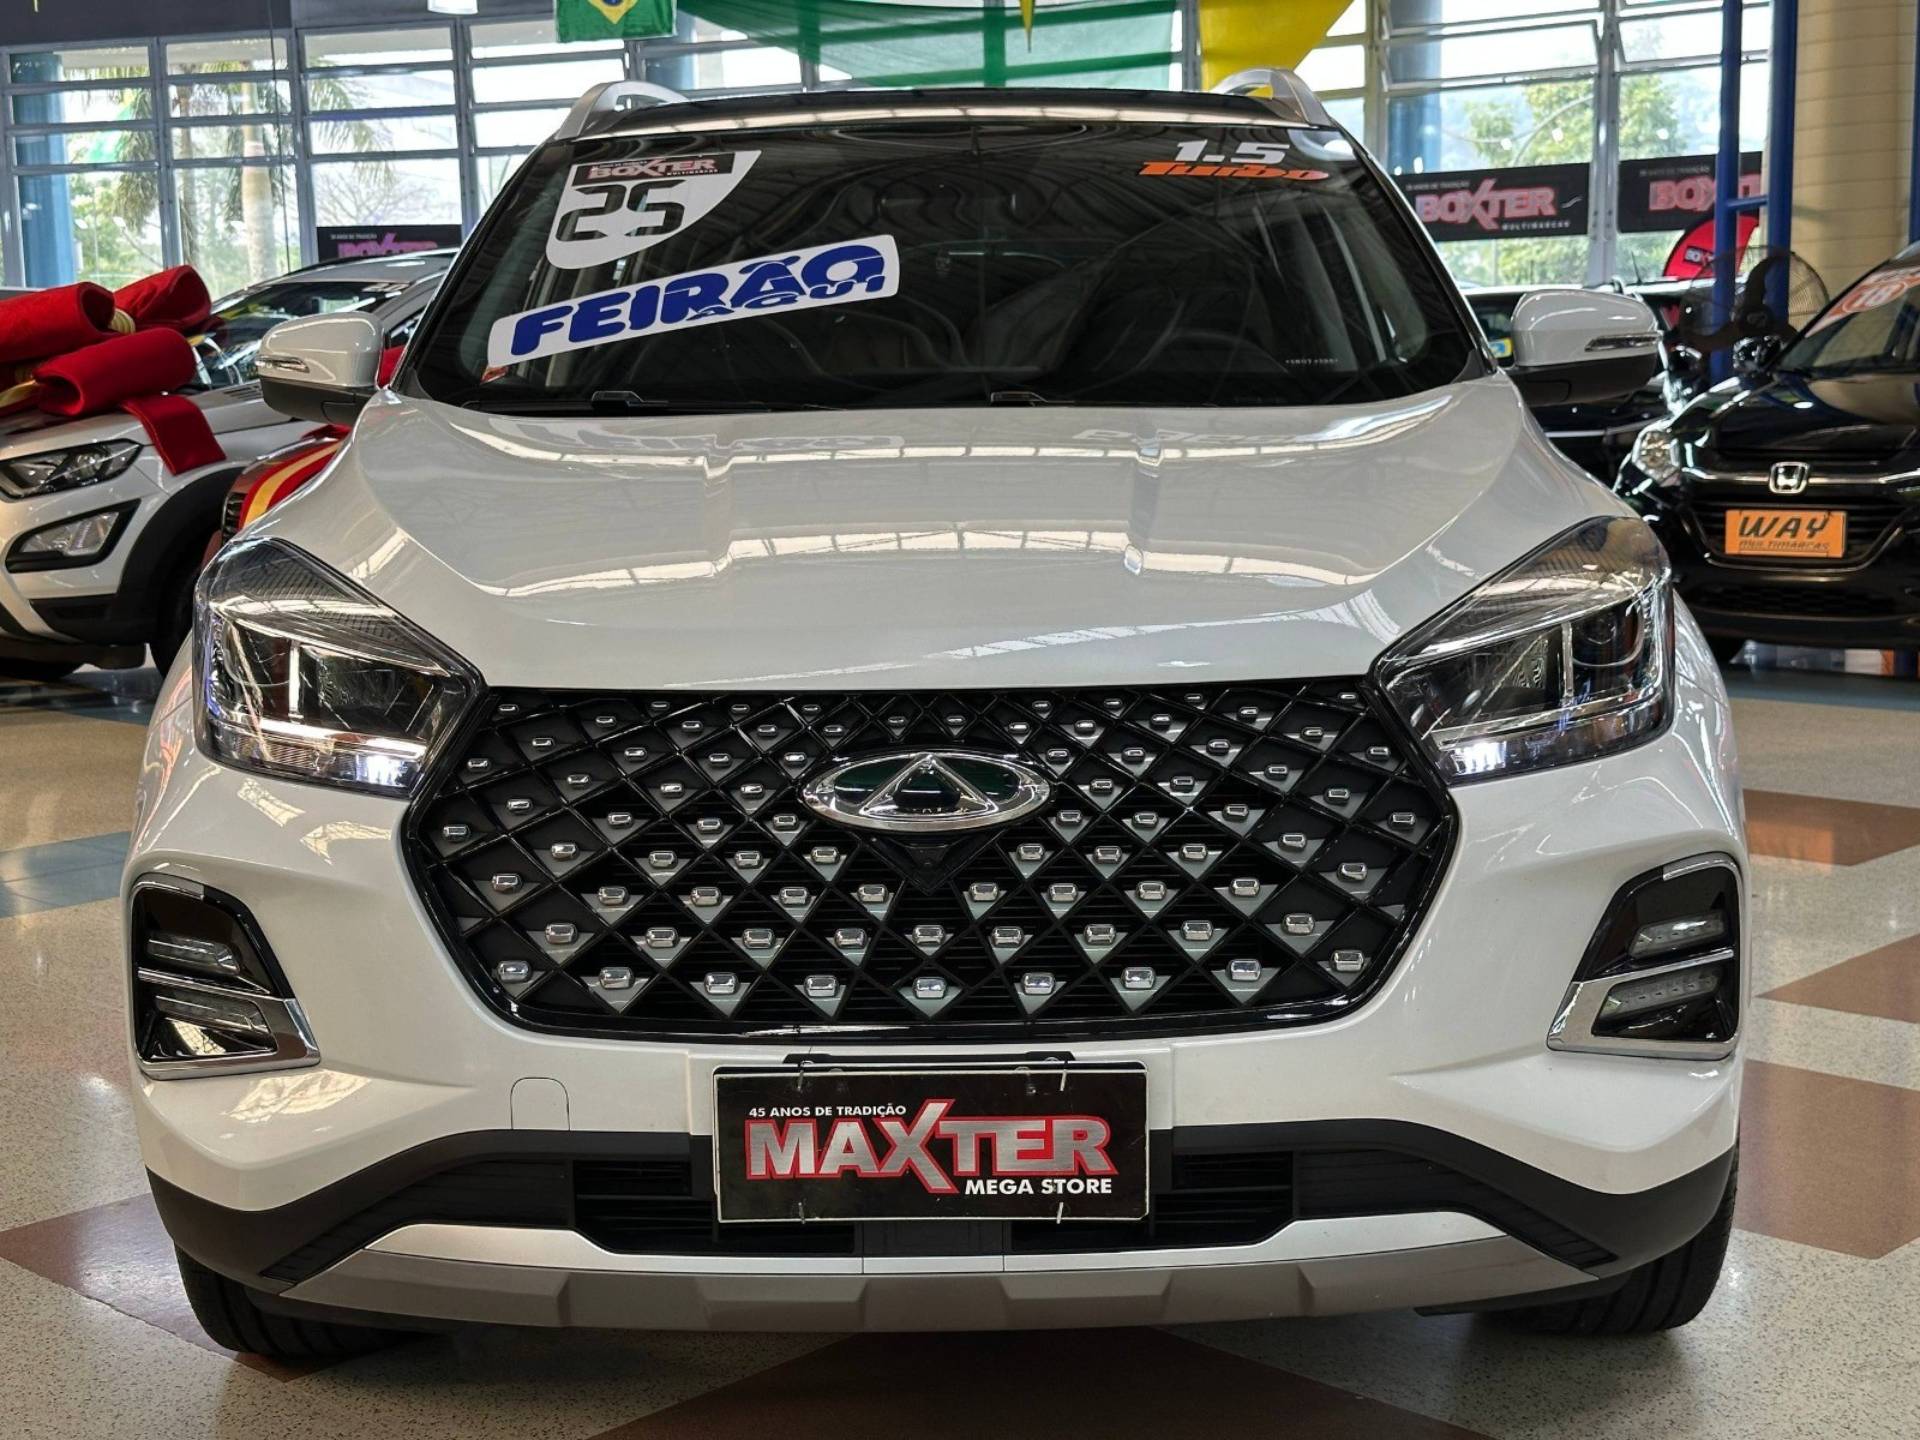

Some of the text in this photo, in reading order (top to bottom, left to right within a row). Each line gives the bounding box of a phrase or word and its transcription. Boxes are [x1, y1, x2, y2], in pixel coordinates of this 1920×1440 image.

[1175, 140, 1290, 164] 1.5
[587, 158, 717, 180] BOXTER
[1138, 161, 1329, 181] Turbo
[557, 180, 686, 241] 25
[1415, 178, 1558, 230] BOXTER
[510, 245, 885, 356] FEIRÃO
[1739, 516, 1830, 539] WAY
[749, 1103, 906, 1117] 45 ANOS DE TRADIÇÃO
[746, 1099, 1117, 1193] MAXTER
[964, 1178, 1112, 1195] MEGA STORE
